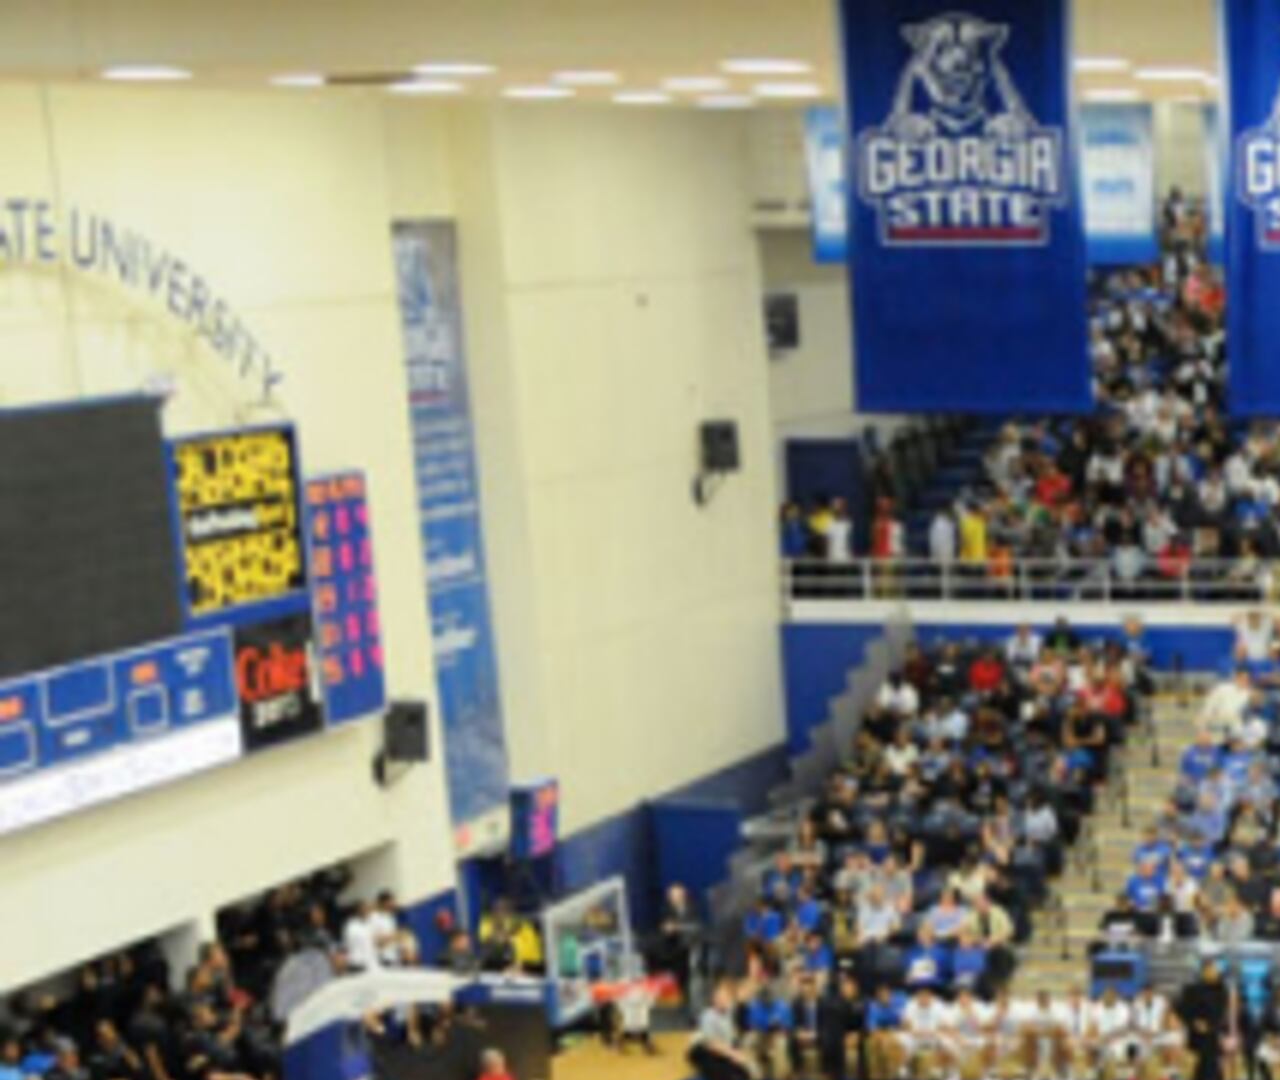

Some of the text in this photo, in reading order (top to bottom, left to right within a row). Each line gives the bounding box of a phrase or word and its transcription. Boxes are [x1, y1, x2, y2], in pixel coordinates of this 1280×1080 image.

[867, 137, 1058, 192] GEORGIA
[889, 192, 1041, 228] STATE
[70, 206, 284, 404] UNIVERSITY
[235, 642, 308, 704] Coke
